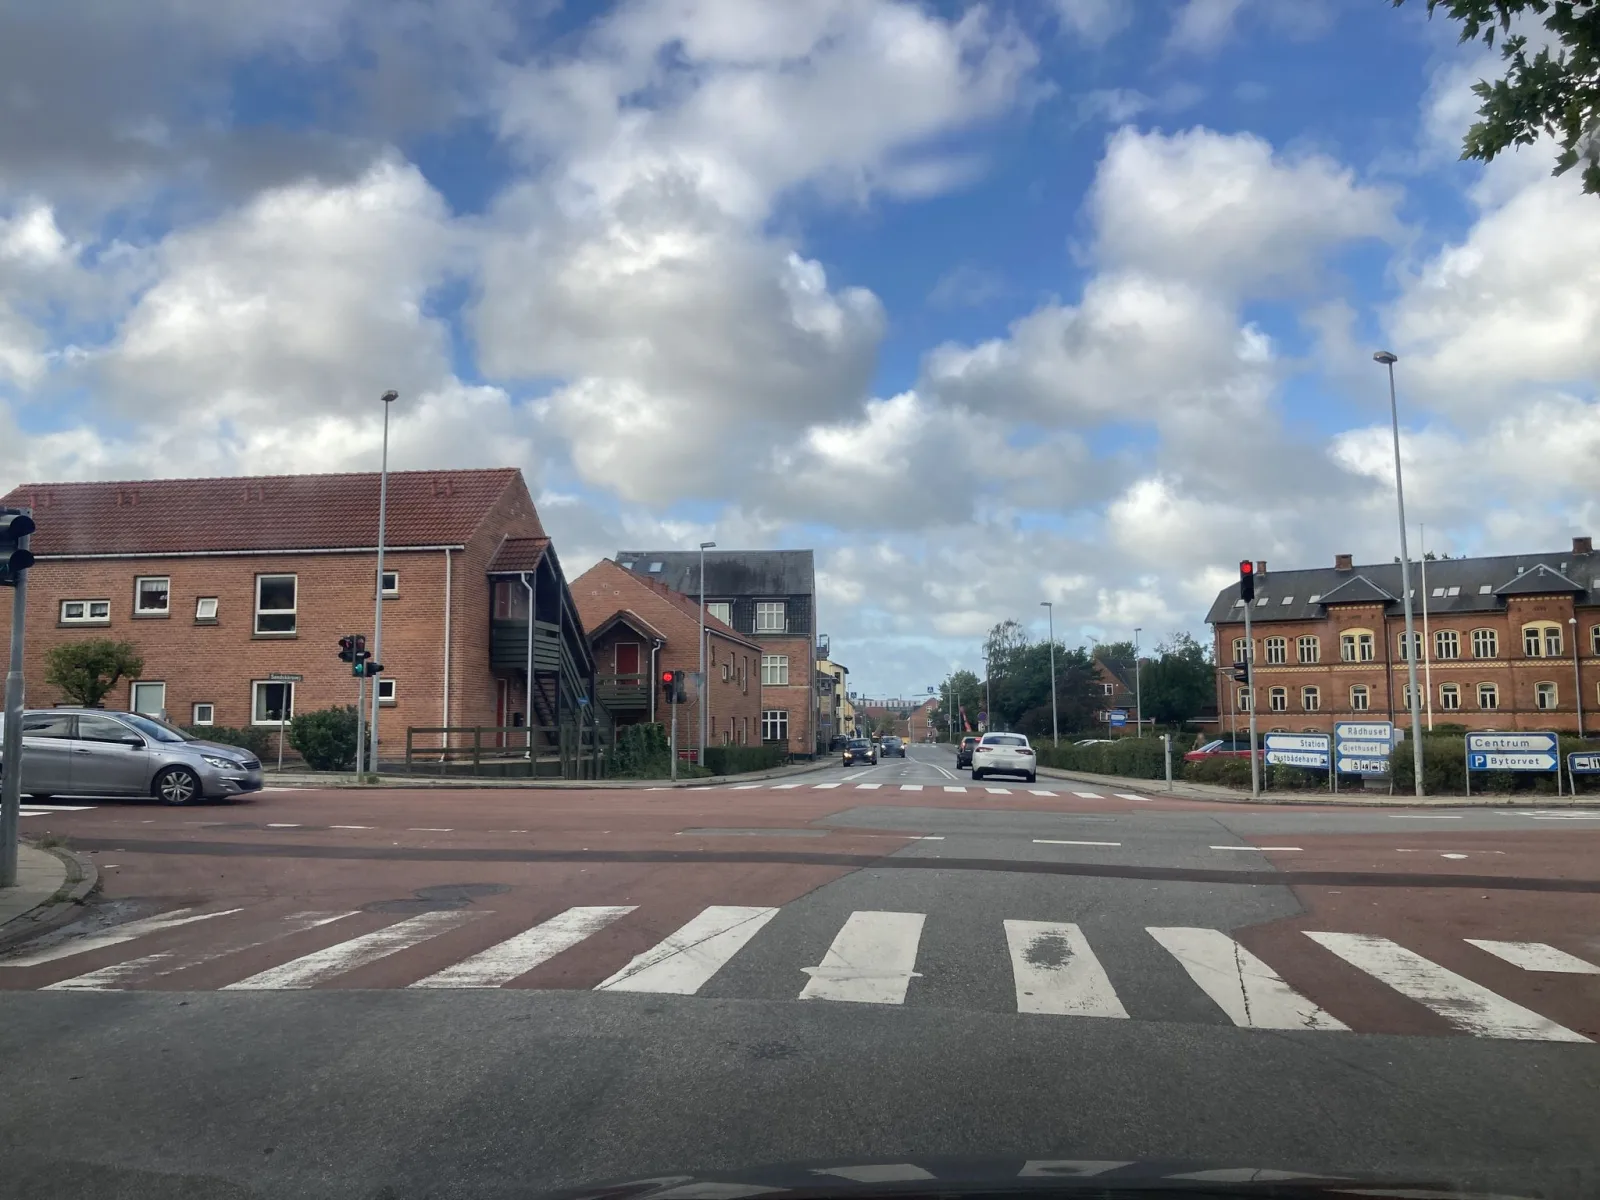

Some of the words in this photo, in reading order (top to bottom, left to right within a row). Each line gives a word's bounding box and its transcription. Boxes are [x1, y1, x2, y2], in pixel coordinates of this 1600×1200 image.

[1347, 726, 1387, 736] Rådhuset
[1300, 739, 1325, 748] Station
[1475, 739, 1530, 747] Centrum
[1342, 744, 1378, 753] Gjethuset
[1475, 756, 1484, 767] P
[1491, 757, 1539, 765] Bytorvet
